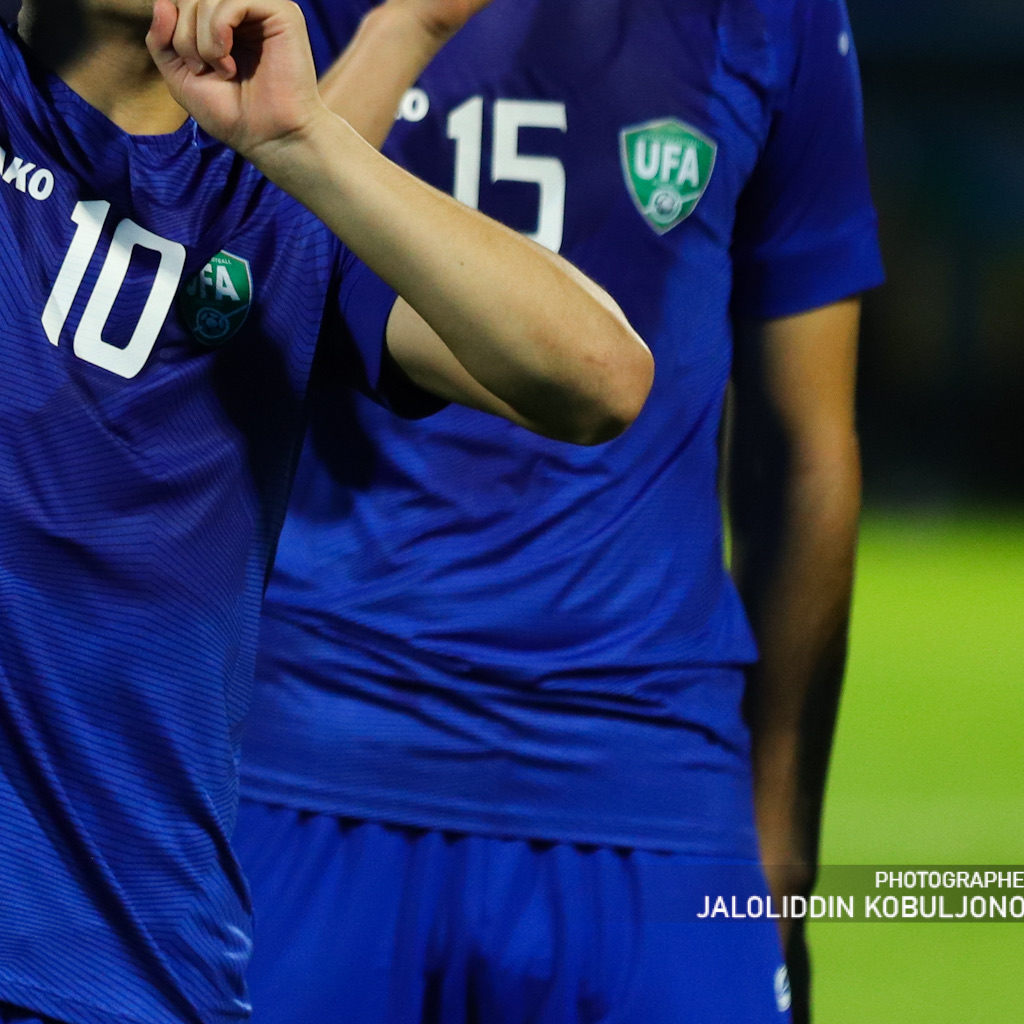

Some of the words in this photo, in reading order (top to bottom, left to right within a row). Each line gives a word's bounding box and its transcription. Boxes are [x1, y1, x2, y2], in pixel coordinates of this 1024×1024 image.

[448, 96, 567, 254] 15
[634, 139, 700, 188] UFA
[41, 200, 186, 379] 10
